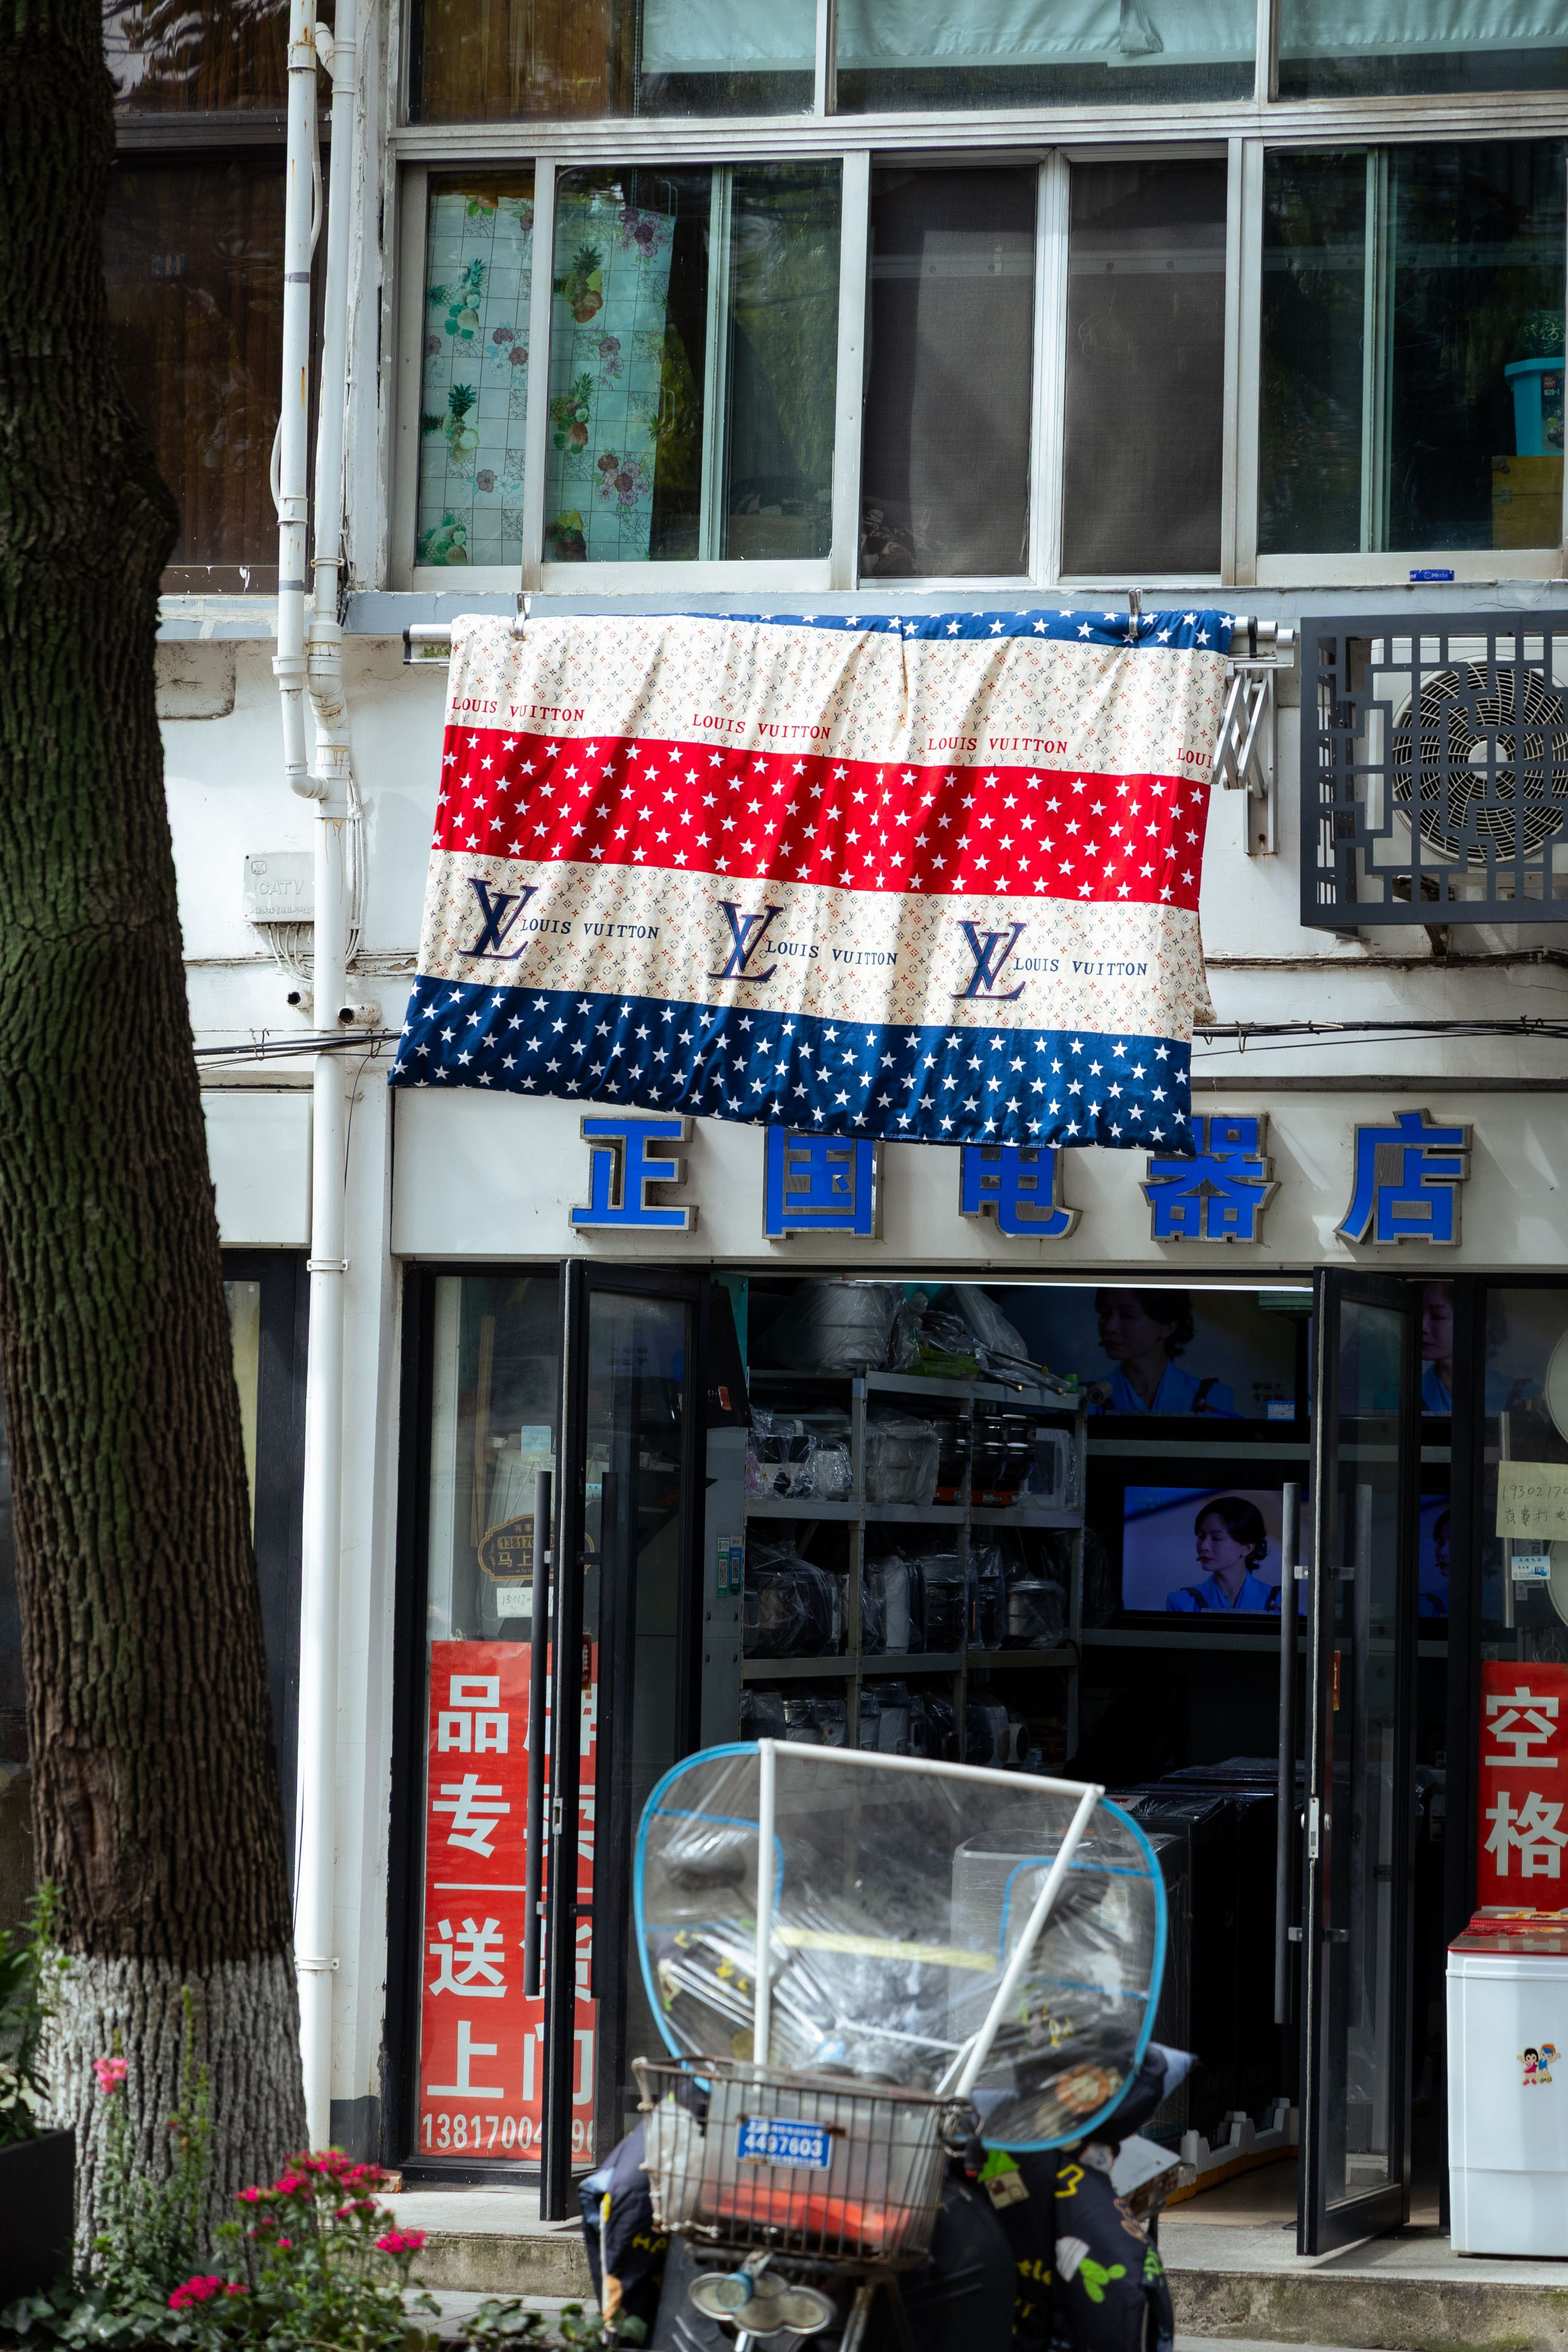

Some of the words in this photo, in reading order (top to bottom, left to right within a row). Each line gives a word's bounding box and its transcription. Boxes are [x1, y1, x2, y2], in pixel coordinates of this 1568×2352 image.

[451, 697, 497, 713] LOUIS
[510, 705, 585, 722] VUITTON
[693, 714, 745, 734] LOUIS
[758, 723, 832, 739] VUITTON
[927, 737, 977, 751] LOUIS
[989, 737, 1068, 754] VUITTON
[1176, 748, 1213, 769] LOUI
[259, 880, 304, 895] CATV
[521, 919, 571, 935] LOUIS
[584, 922, 660, 939] VUITTON
[766, 940, 820, 959] LOUIS
[832, 948, 899, 966] VUITTON
[1014, 957, 1059, 972] LOUIS
[1072, 960, 1148, 976] VUITTON
[568, 1107, 1472, 1246] 正国电器店
